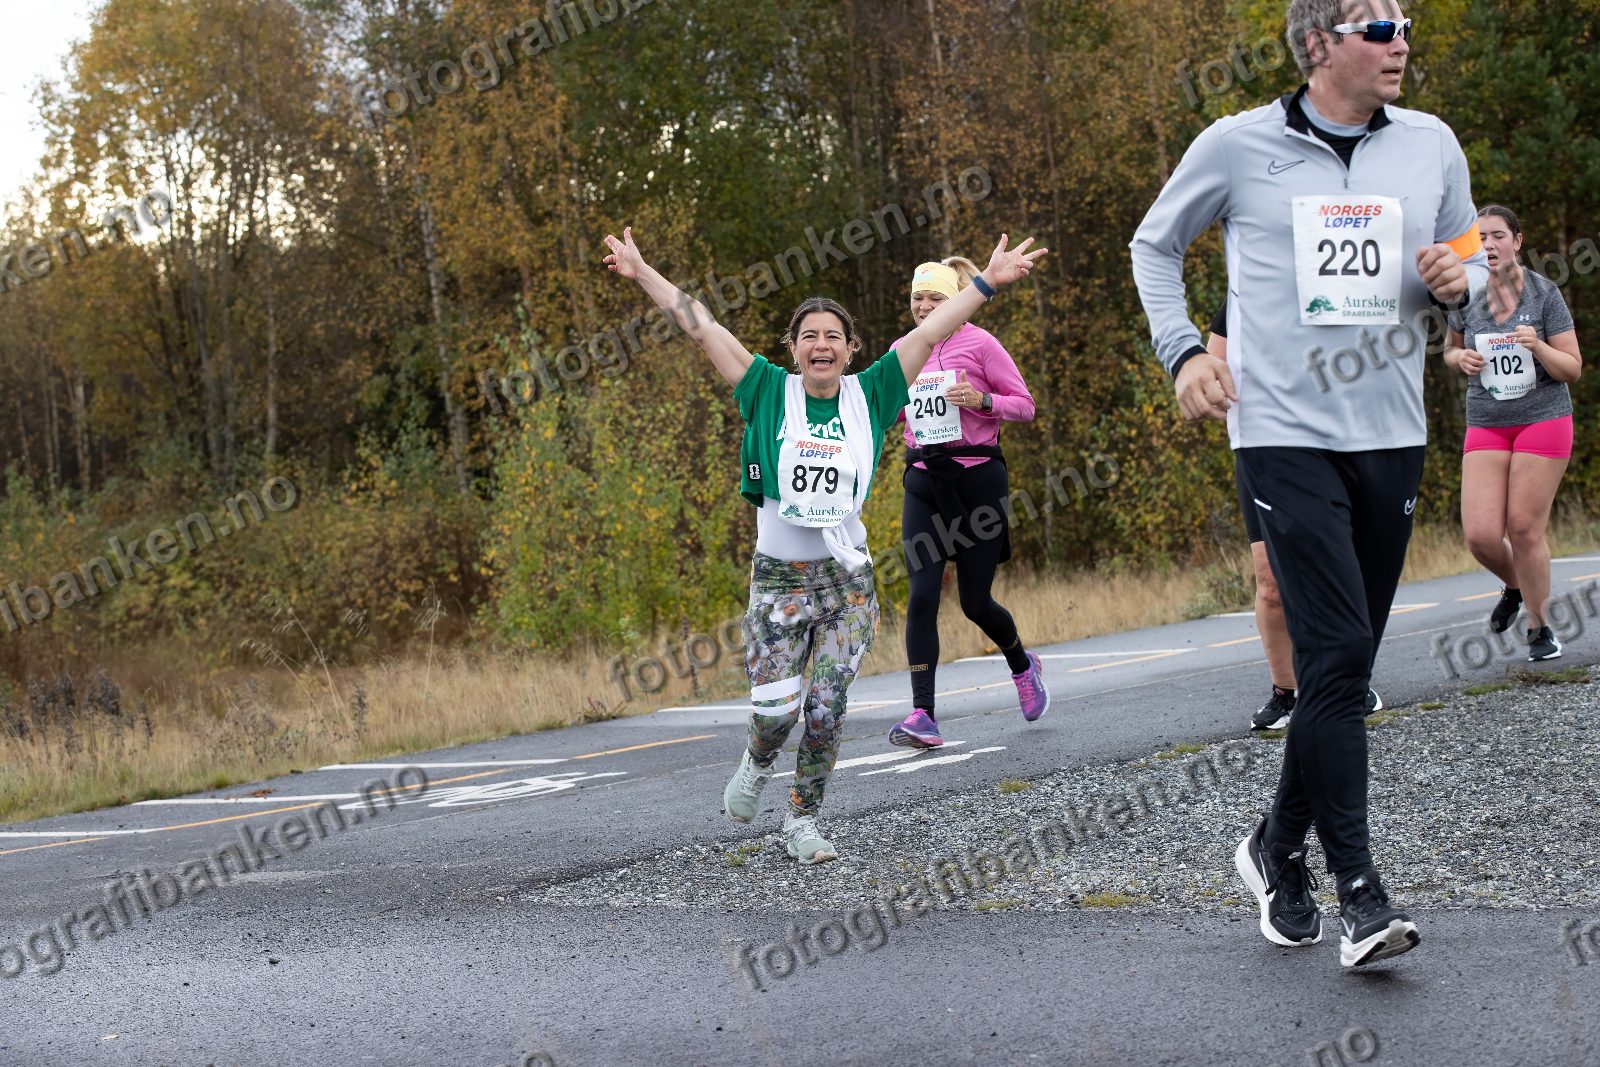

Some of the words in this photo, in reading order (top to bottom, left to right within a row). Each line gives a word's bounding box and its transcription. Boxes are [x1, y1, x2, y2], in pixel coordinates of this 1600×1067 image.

[1318, 205, 1383, 216] NORGES
[1324, 217, 1372, 228] LØPET
[1317, 238, 1382, 277] 220
[1342, 295, 1397, 312] Aurskog
[1490, 355, 1524, 376] 102
[913, 376, 945, 386] NORGES
[913, 395, 947, 420] 240
[928, 425, 958, 435] Aurskog
[795, 440, 842, 453] NORGES
[799, 448, 836, 460] LØPET
[791, 464, 839, 495] 879
